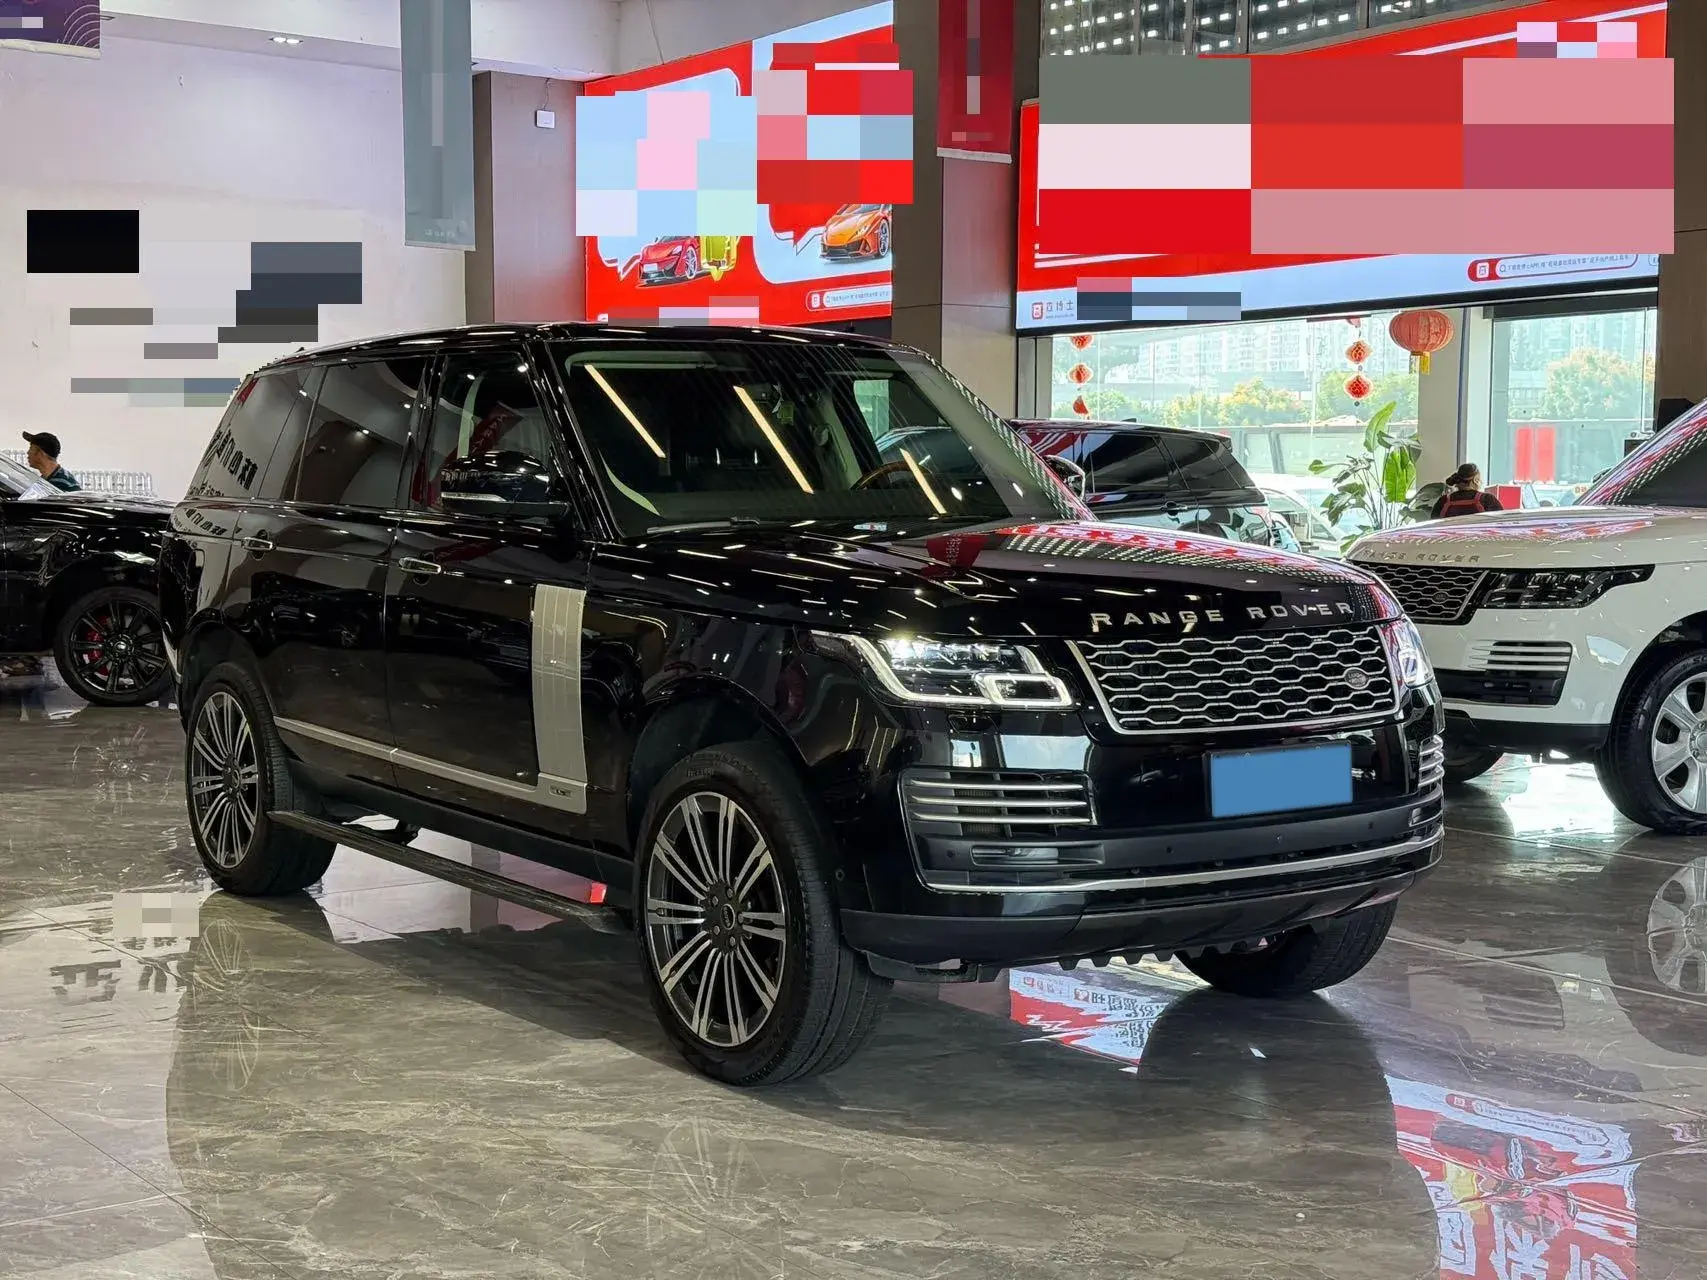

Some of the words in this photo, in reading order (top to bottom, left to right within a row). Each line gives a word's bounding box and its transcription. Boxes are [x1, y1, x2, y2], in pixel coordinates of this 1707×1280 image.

[1416, 552, 1480, 564] ROVER
[1090, 609, 1224, 626] RANGE
[1246, 602, 1354, 620] ROVER
